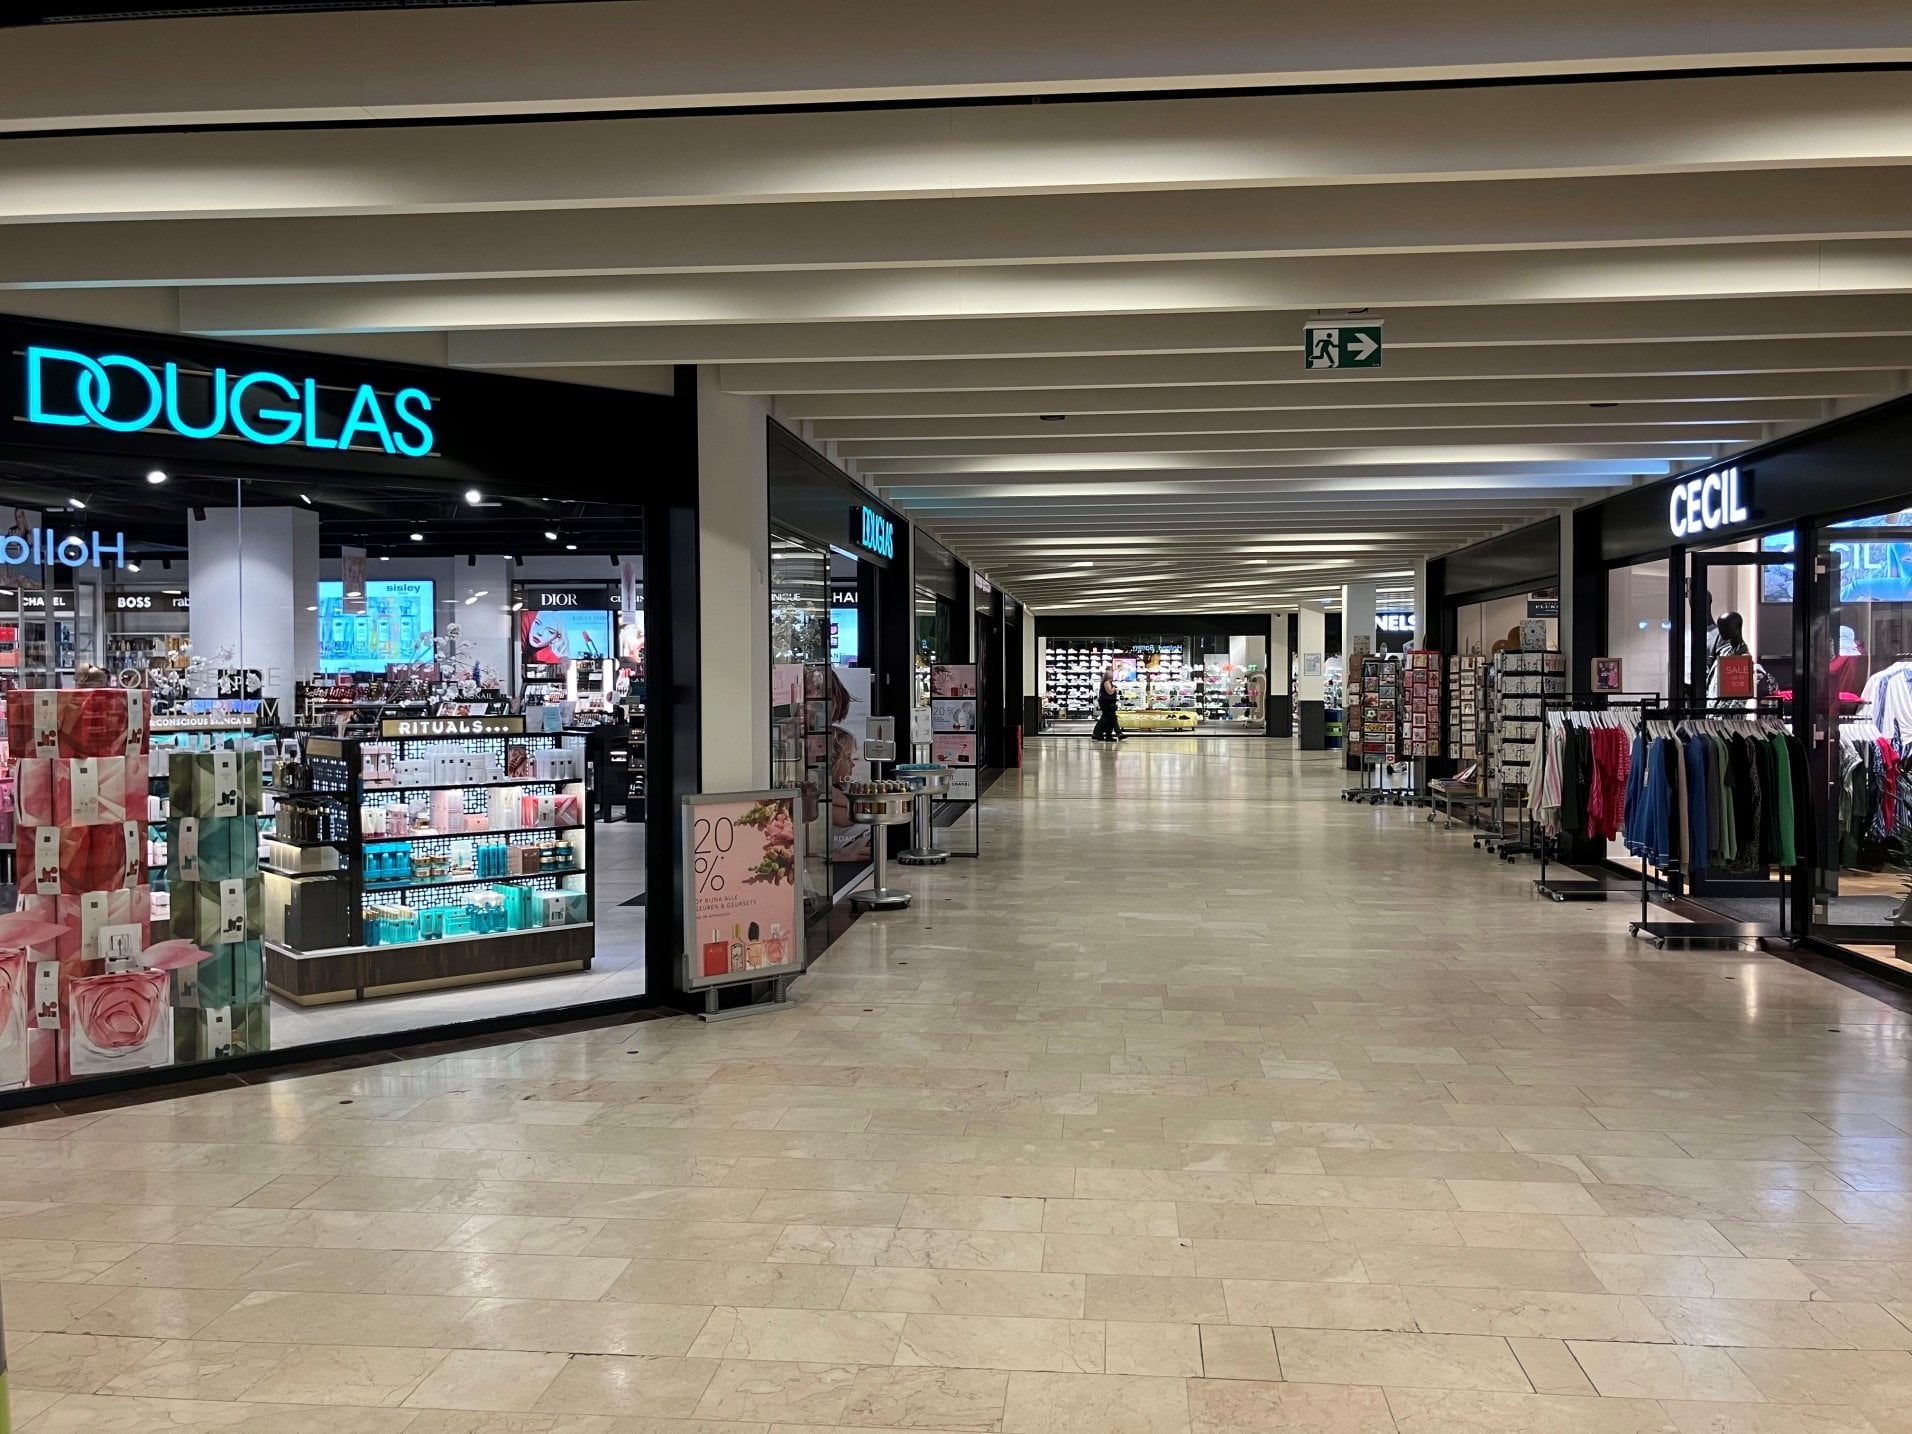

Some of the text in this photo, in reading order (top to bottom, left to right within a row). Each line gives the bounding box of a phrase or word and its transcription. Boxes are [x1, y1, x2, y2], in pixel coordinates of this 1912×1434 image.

[26, 346, 435, 457] DOUGLAS
[1670, 467, 1748, 538] CECIL
[862, 505, 894, 560] DOUGLAS
[22, 597, 66, 606] CHAEL
[386, 584, 421, 593] sisley
[541, 593, 578, 606] DIOR
[117, 597, 152, 608] BOSS
[694, 816, 734, 855] 20
